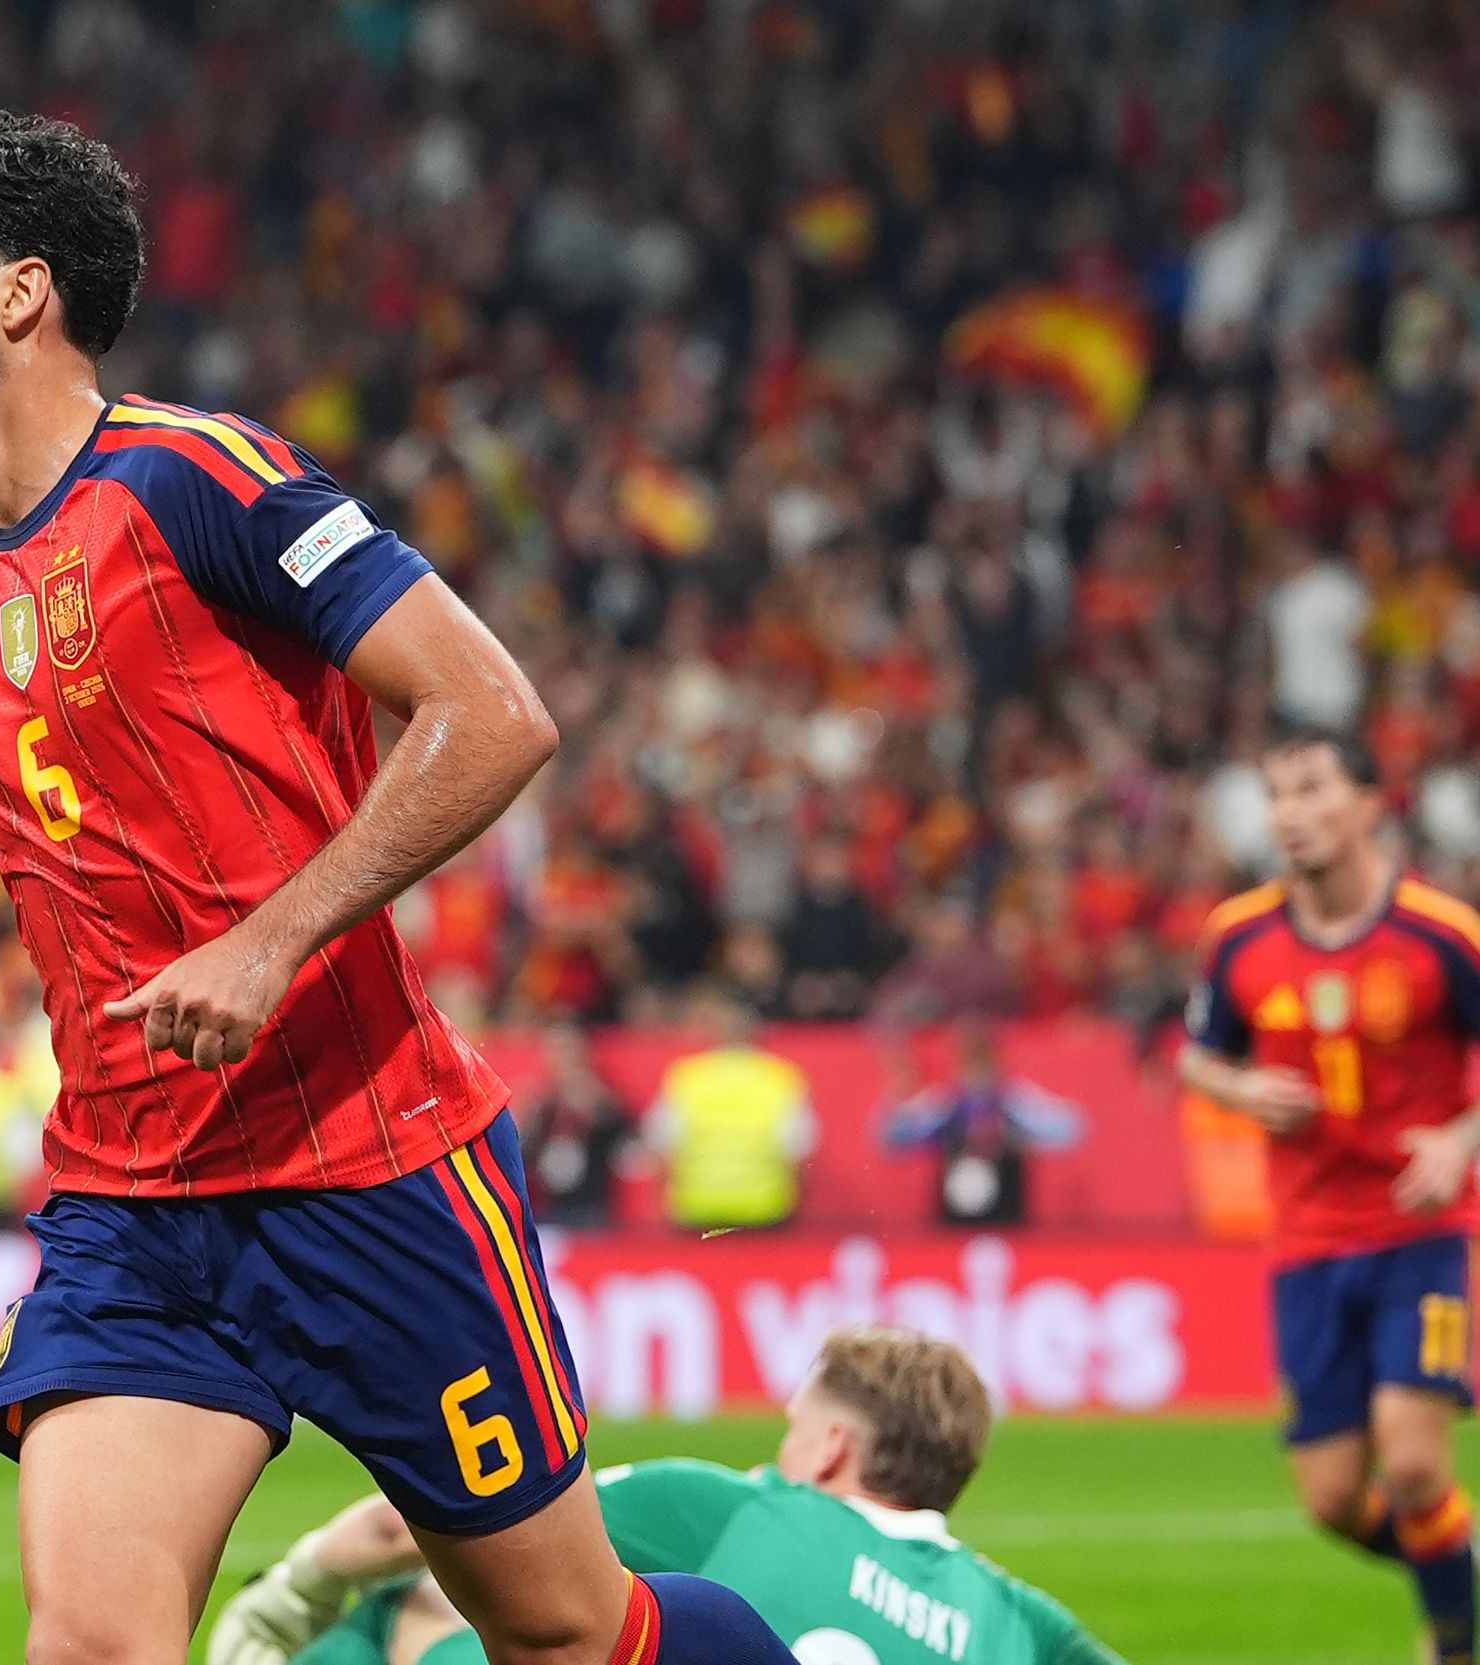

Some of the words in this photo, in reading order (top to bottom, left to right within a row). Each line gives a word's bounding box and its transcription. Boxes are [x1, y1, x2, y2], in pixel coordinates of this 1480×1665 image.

[17, 715, 81, 842] 6
[440, 1366, 524, 1497] 6
[849, 1553, 971, 1662] KINSKY
